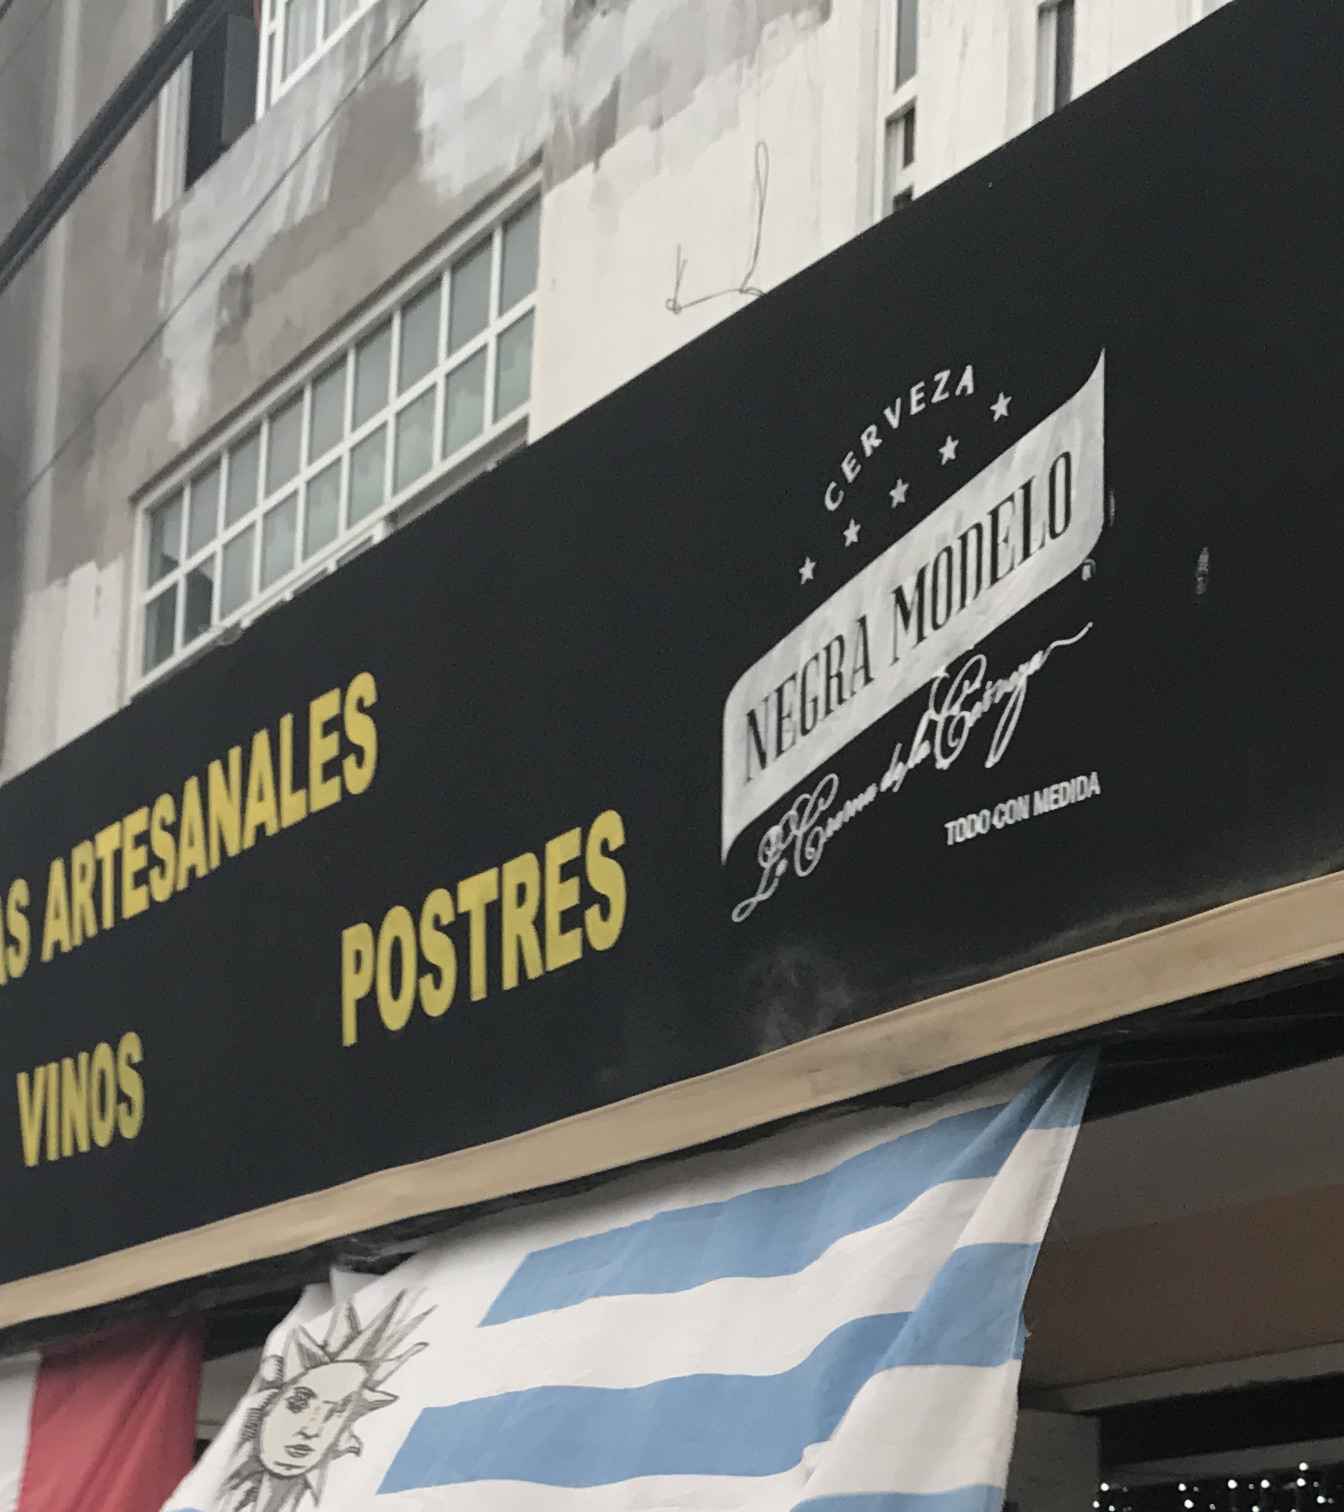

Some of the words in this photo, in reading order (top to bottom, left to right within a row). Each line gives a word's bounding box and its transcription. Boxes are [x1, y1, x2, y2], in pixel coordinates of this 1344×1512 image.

[823, 364, 975, 511] CERVEZA
[742, 615, 875, 784] NEGRA
[887, 450, 1073, 668] MODELO
[42, 671, 378, 964] ARTESANALES
[944, 809, 991, 846] TODO
[992, 794, 1030, 829] CON
[1033, 771, 1101, 816] MEDIDA
[340, 809, 627, 1047] POSTRES
[17, 1031, 144, 1167] VINOS
